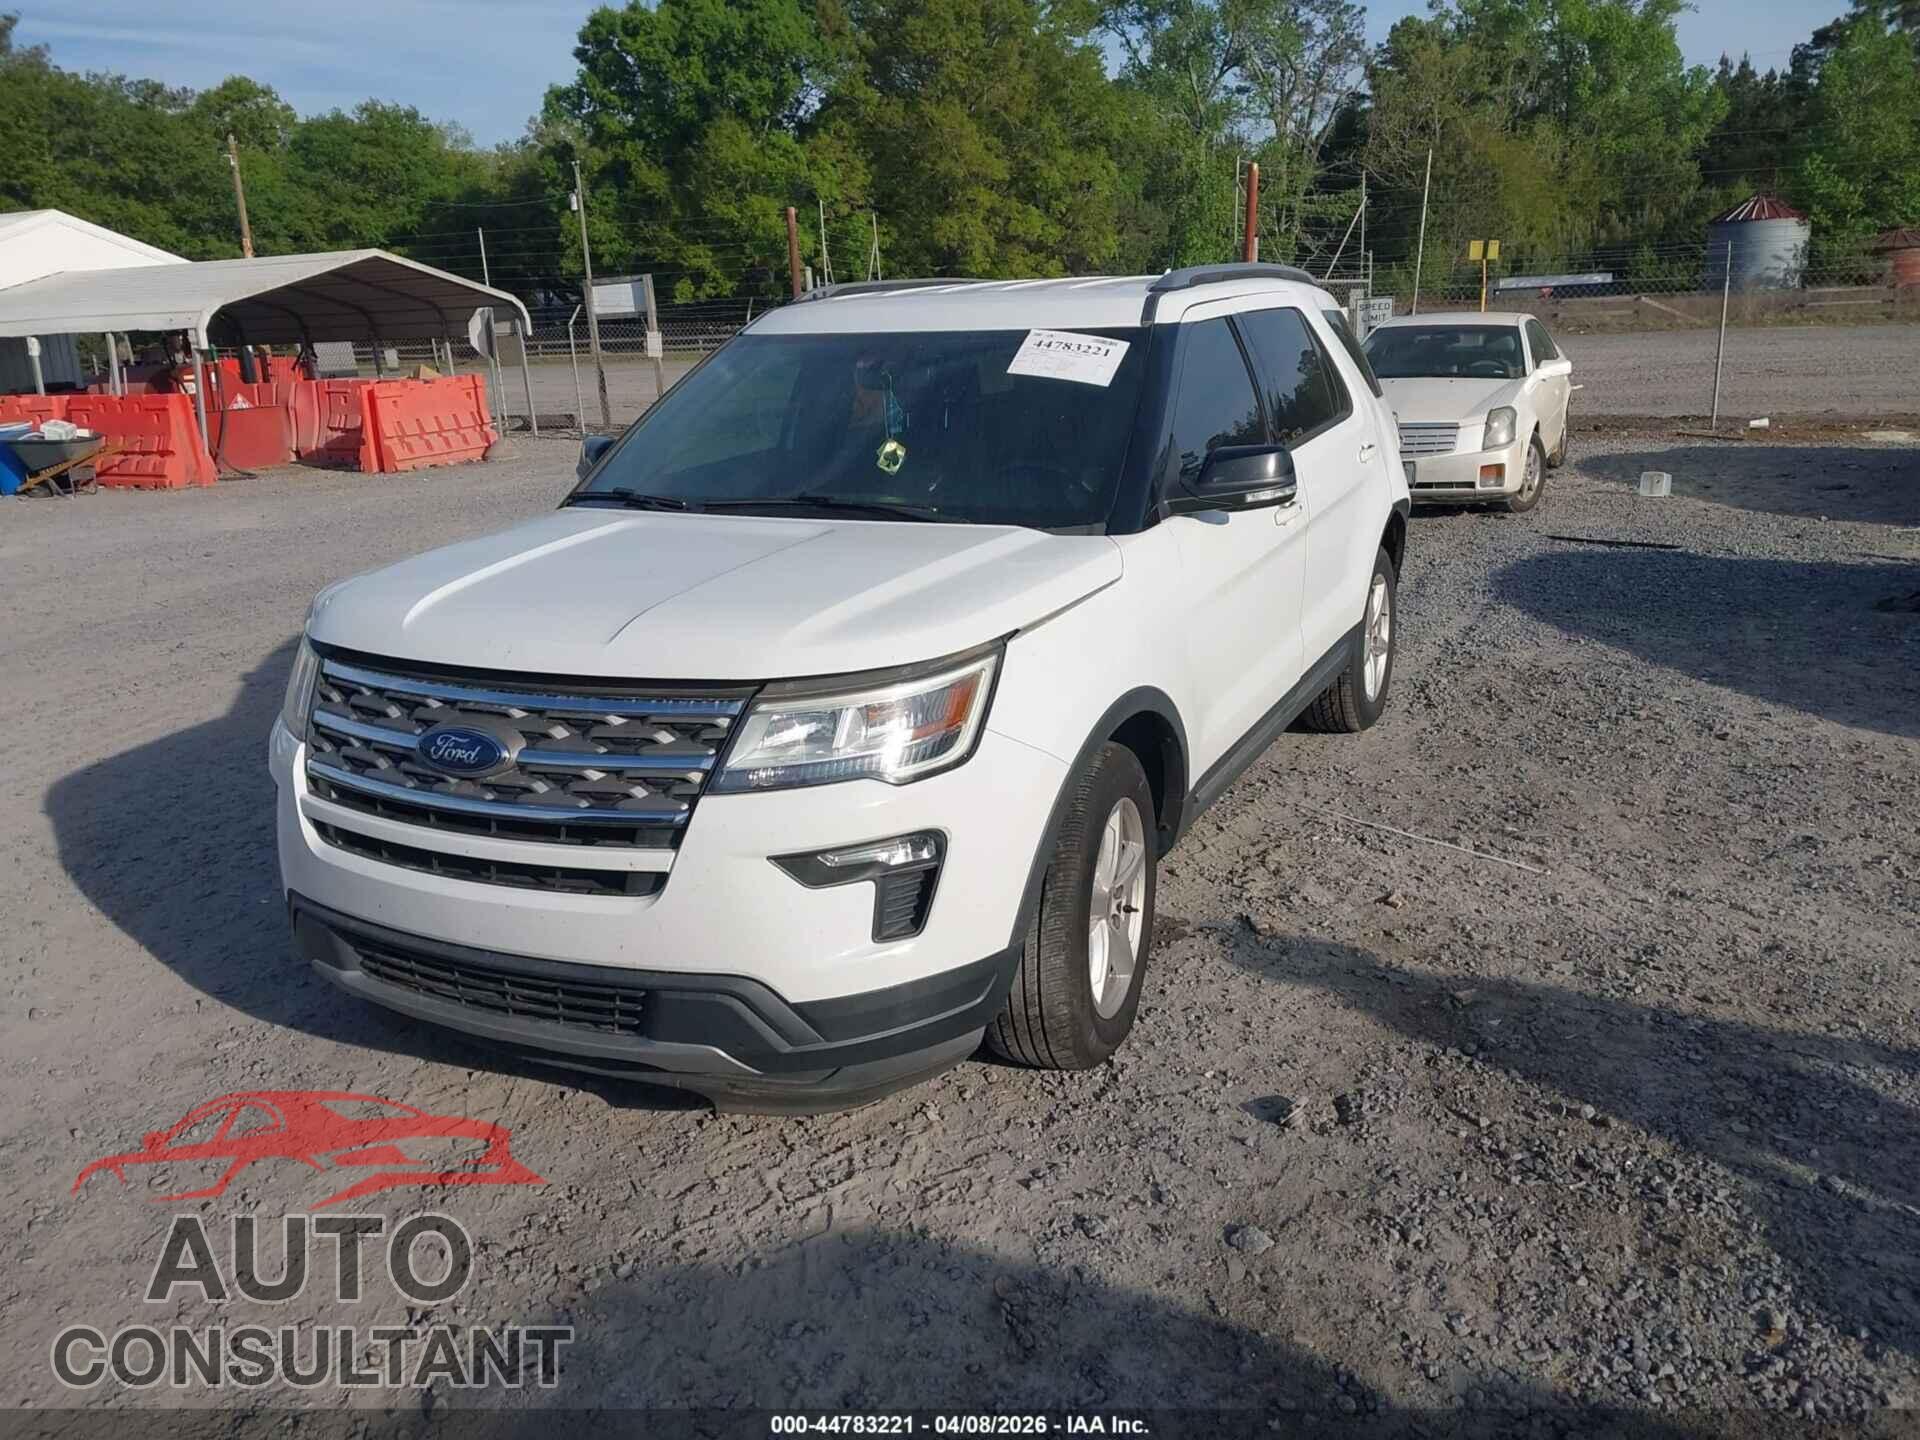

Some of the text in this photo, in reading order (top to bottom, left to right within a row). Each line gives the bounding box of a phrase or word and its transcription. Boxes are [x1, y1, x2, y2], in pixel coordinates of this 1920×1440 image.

[1359, 302, 1390, 312] SPEED
[1361, 313, 1386, 323] LIMIT
[1033, 340, 1110, 357] 44783221
[431, 734, 481, 764] Ford
